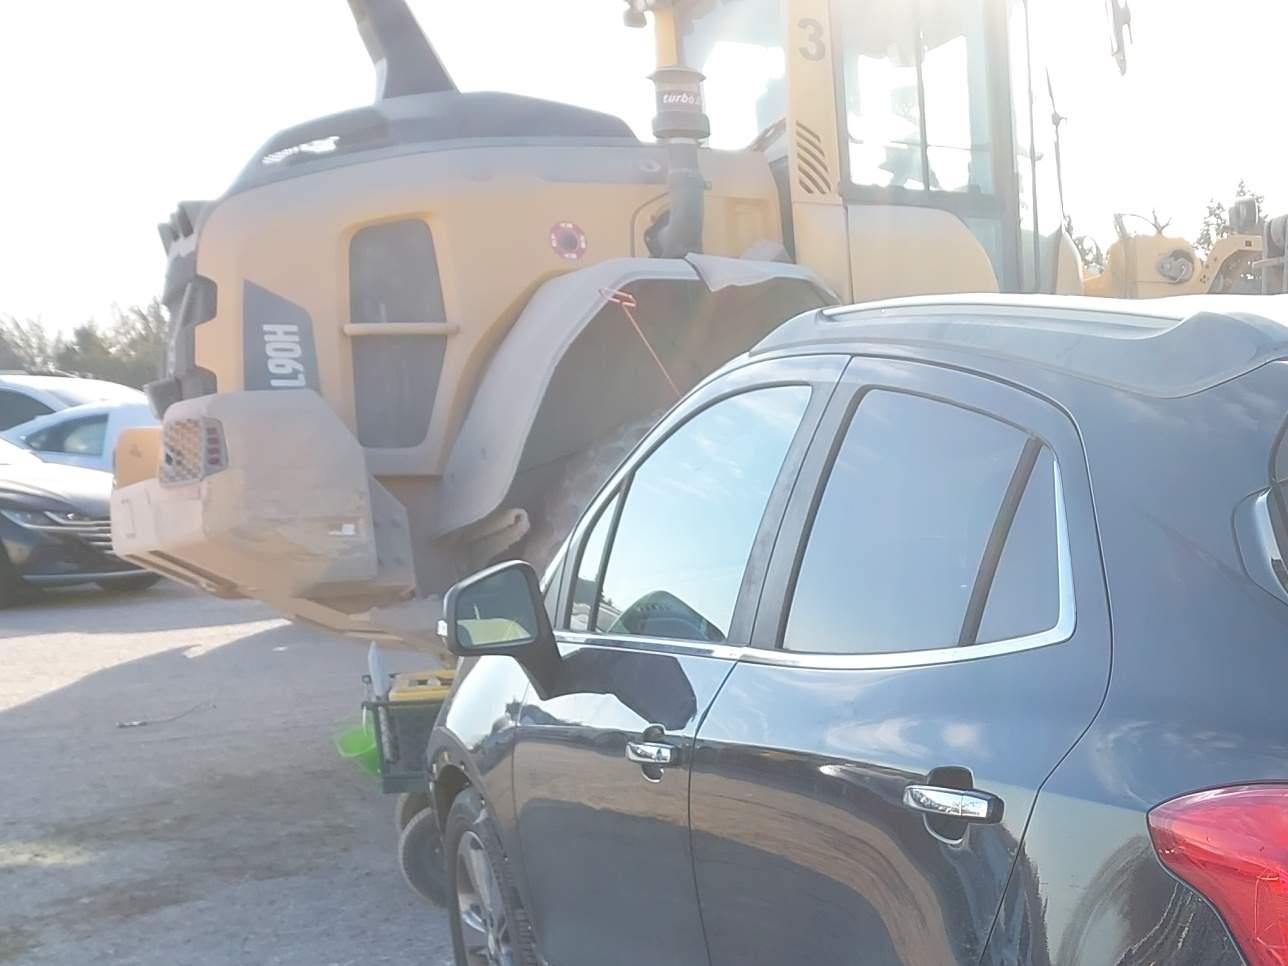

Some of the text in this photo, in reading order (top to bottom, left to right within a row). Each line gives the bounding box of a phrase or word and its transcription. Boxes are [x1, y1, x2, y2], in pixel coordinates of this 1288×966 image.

[797, 17, 826, 61] 3
[662, 92, 696, 105] turbo
[262, 323, 306, 387] L90H
